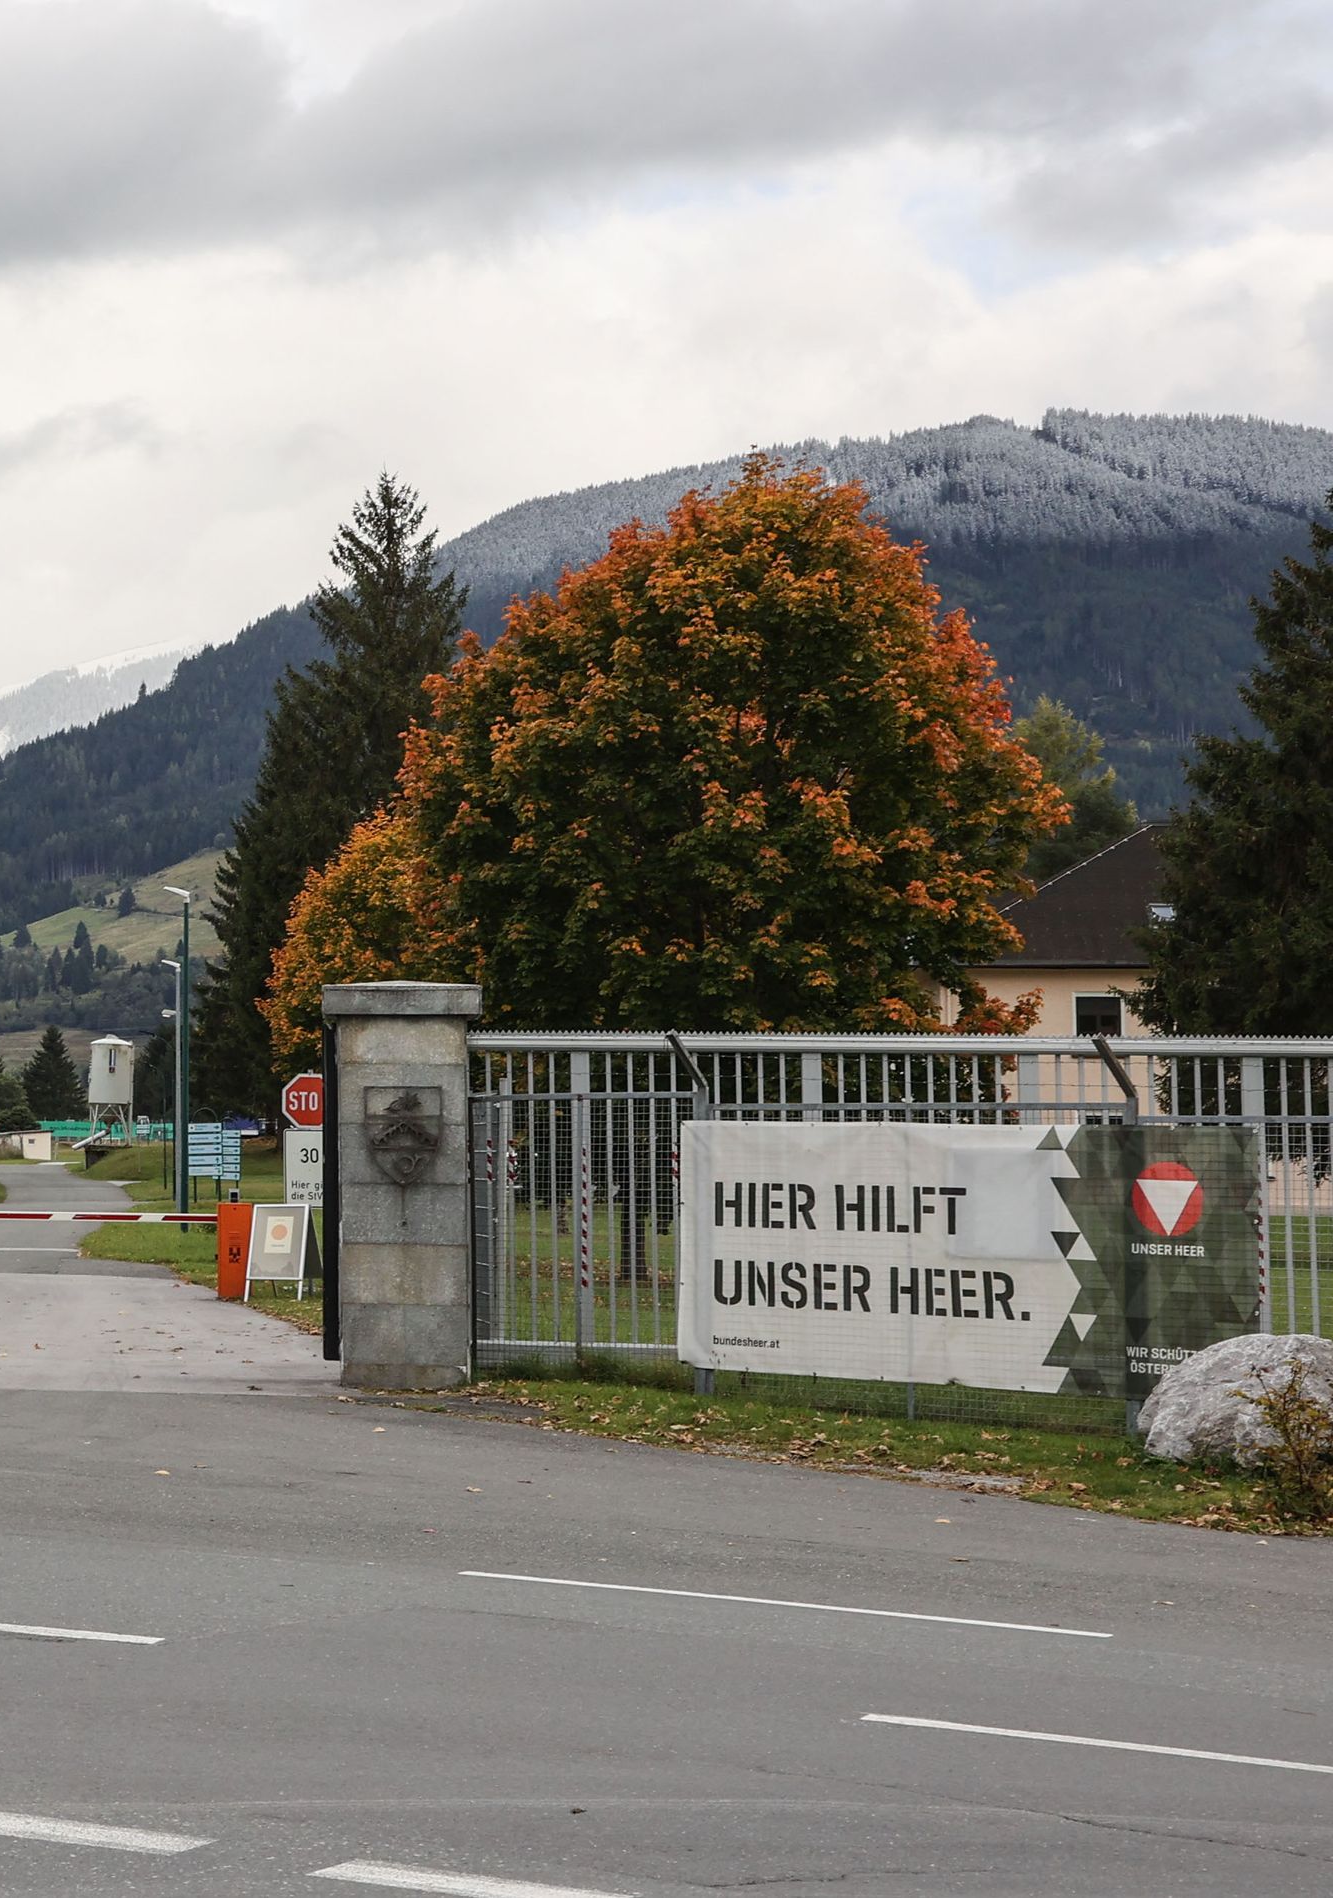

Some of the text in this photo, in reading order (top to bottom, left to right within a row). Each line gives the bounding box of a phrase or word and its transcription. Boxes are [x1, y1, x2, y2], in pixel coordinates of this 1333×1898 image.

[289, 1091, 318, 1111] STO
[300, 1148, 319, 1163] 30
[291, 1181, 310, 1189] Hier
[291, 1192, 323, 1200] die StV
[714, 1181, 967, 1235] HIER HILFT
[1131, 1243, 1205, 1257] UNSER HEER
[713, 1260, 1031, 1321] UNSER HEER.
[713, 1335, 780, 1349] bundesheer.at
[1126, 1346, 1148, 1358] WIR
